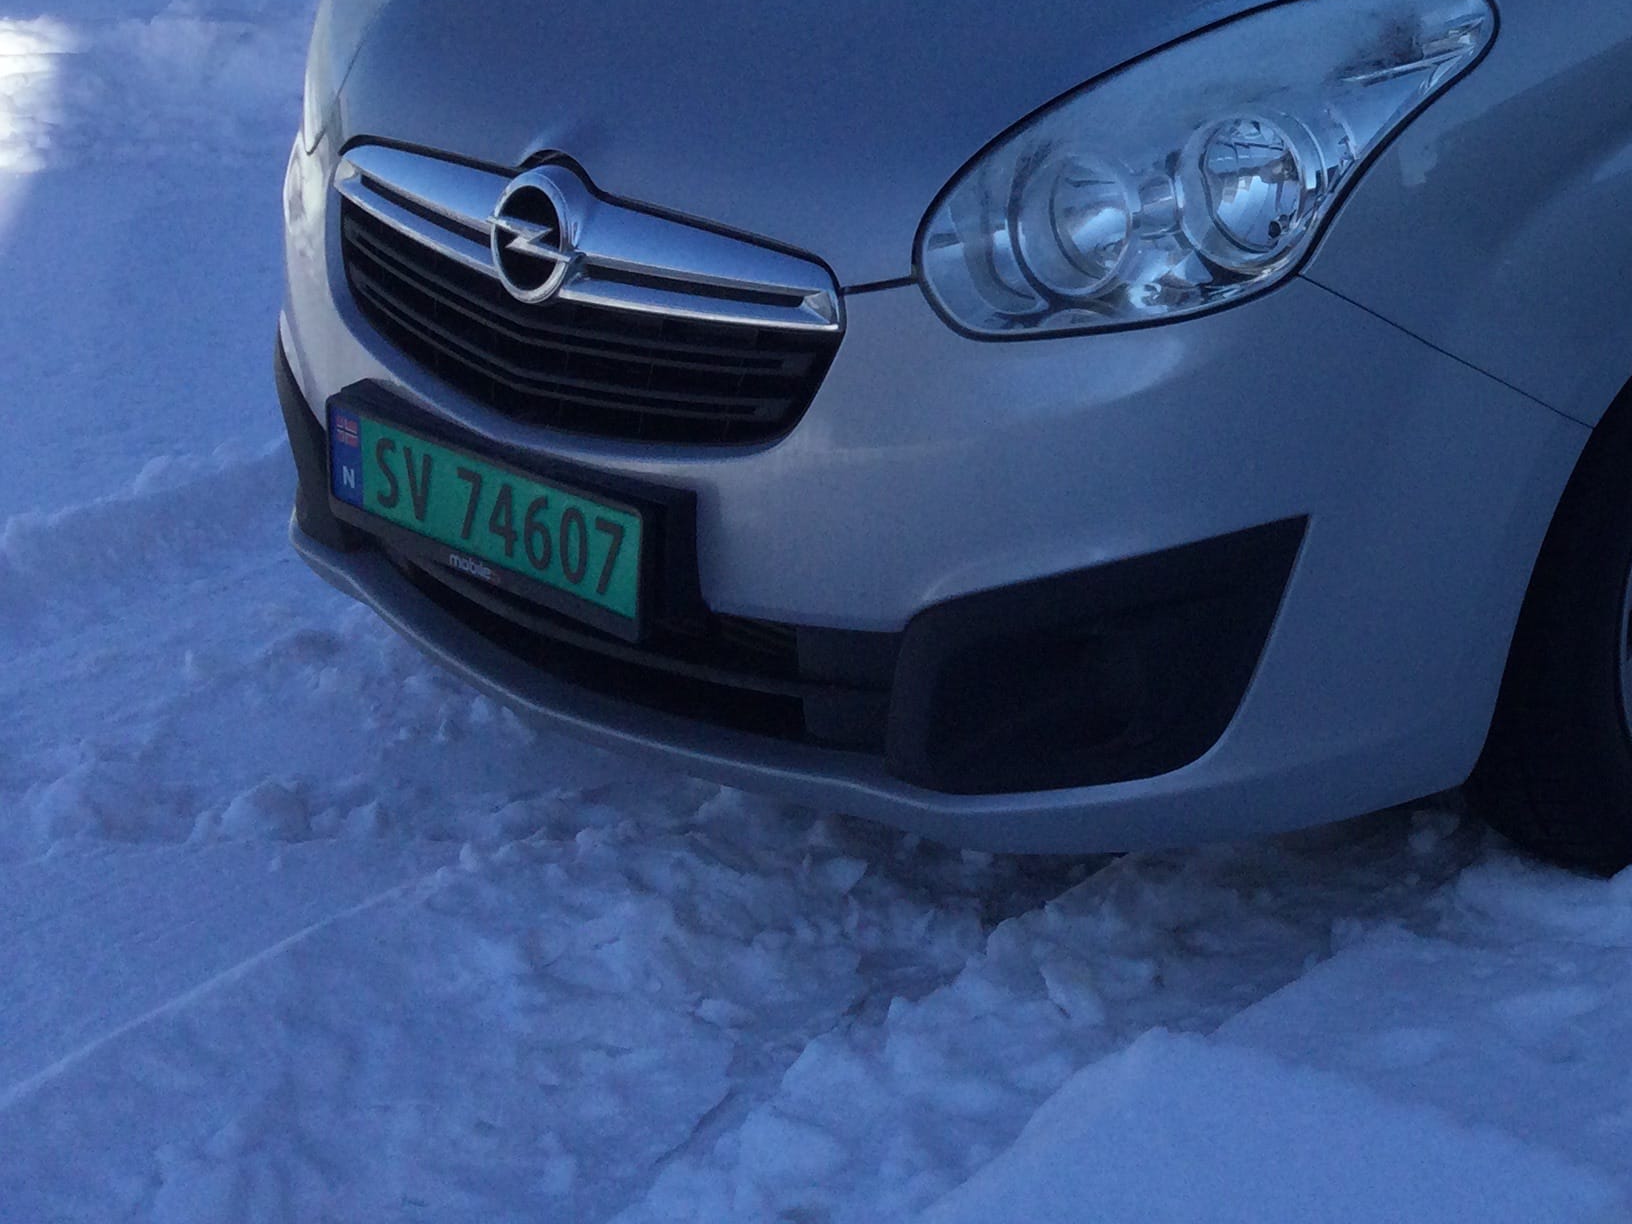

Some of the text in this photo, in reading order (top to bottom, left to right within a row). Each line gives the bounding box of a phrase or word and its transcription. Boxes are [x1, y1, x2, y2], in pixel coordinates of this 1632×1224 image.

[342, 465, 356, 489] N
[375, 437, 625, 595] SV 74607
